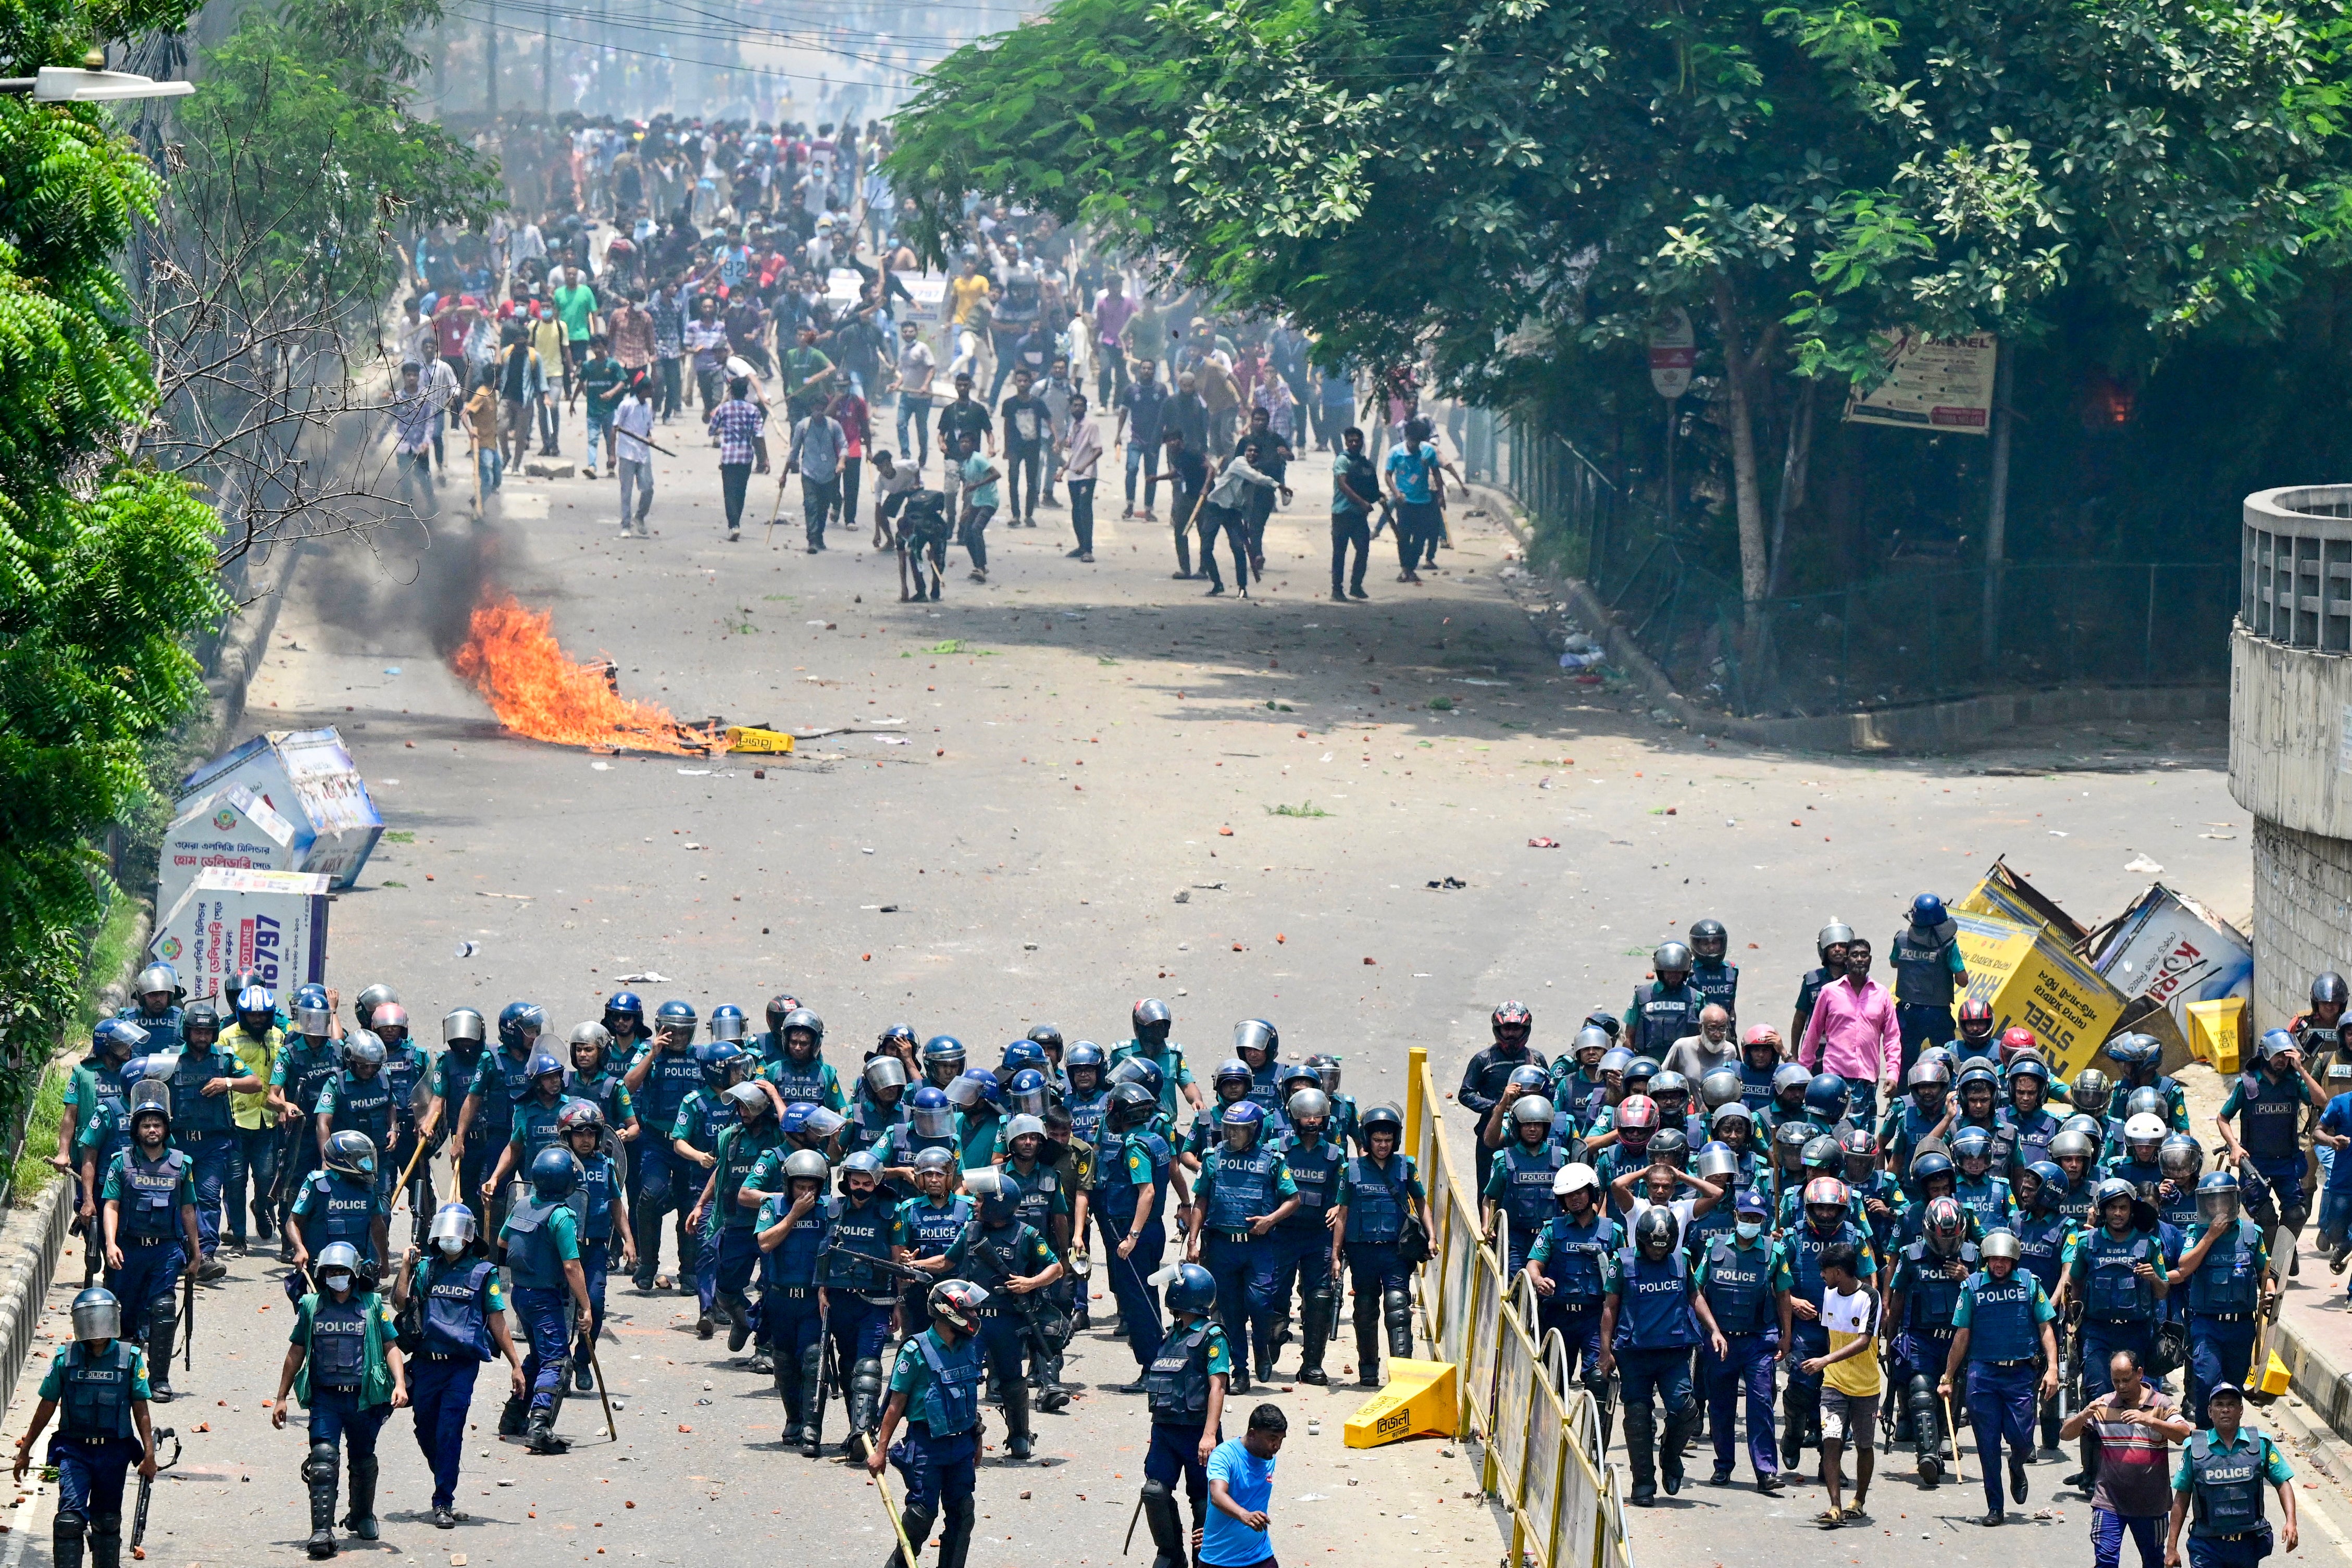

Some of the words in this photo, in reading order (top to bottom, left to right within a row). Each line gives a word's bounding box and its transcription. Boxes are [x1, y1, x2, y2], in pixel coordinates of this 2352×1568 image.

[724, 261, 745, 276] 92
[202, 841, 234, 852] এলপিজি
[173, 855, 196, 866] হোম
[214, 901, 222, 920] পেতে
[207, 921, 223, 973] ডেলিভারি
[194, 938, 204, 972] এলপিজি
[1900, 949, 1936, 961] POLICE
[225, 959, 231, 974] কল
[1702, 985, 1728, 993] POLICE
[1646, 1001, 1685, 1011] POLICE
[501, 1026, 513, 1035] POLICE
[2023, 1000, 2075, 1052] STEEL
[126, 1069, 139, 1078] POLICE
[665, 1068, 696, 1076] POLICE
[706, 1064, 722, 1074] POLICE
[785, 1087, 817, 1096] POLICE
[351, 1097, 388, 1108] POLICE
[2259, 1104, 2288, 1113] POLICE
[1219, 1159, 1263, 1172] POLICE
[1289, 1169, 1324, 1179] POLICE
[135, 1176, 175, 1187] POLICE
[2046, 1183, 2063, 1193] POLICE
[328, 1200, 367, 1210] POLICE
[1974, 1203, 1994, 1212] LICE
[2059, 1204, 2089, 1213] OLICE
[837, 1225, 874, 1237] POLICE
[920, 1229, 955, 1238] POLICE
[2099, 1256, 2134, 1265] POLICE
[1716, 1270, 1756, 1282] POLICE
[432, 1285, 469, 1297] POLICE
[1639, 1280, 1677, 1293] POLICE
[1977, 1289, 2025, 1303] POLICE
[316, 1322, 364, 1333] POLICE
[1154, 1359, 1185, 1368] POLICE
[948, 1368, 970, 1378] POLICE
[1377, 1409, 1411, 1434] বিজলী
[2206, 1467, 2250, 1480] POLICE
